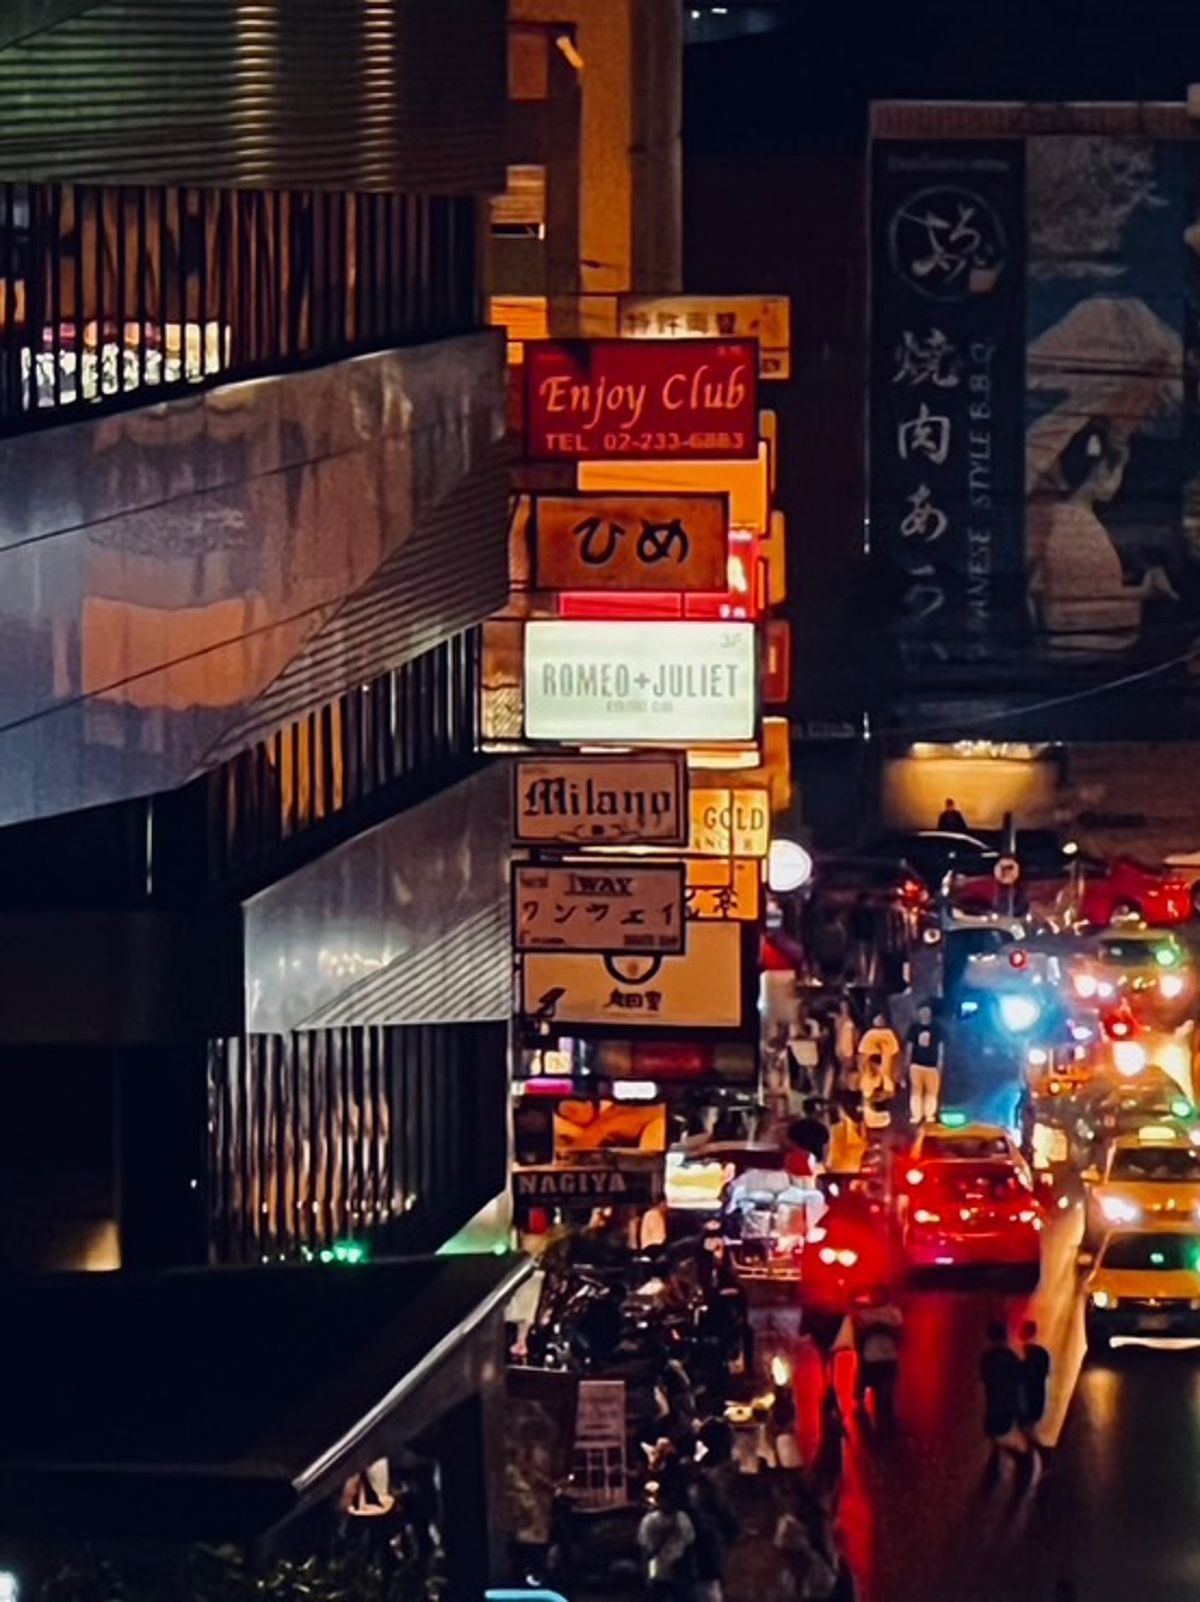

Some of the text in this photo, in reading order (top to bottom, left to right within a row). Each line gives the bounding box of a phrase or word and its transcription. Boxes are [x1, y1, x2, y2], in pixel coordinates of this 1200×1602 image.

[539, 365, 746, 429] Enjoy Club
[545, 433, 589, 452] TEL
[967, 431, 992, 509] STYLE
[572, 517, 690, 566] ひめ
[542, 663, 739, 699] ROMEO+JULIET
[522, 777, 671, 827] Milano
[703, 806, 765, 831] GOLD
[518, 1172, 627, 1195] NAGIYA
